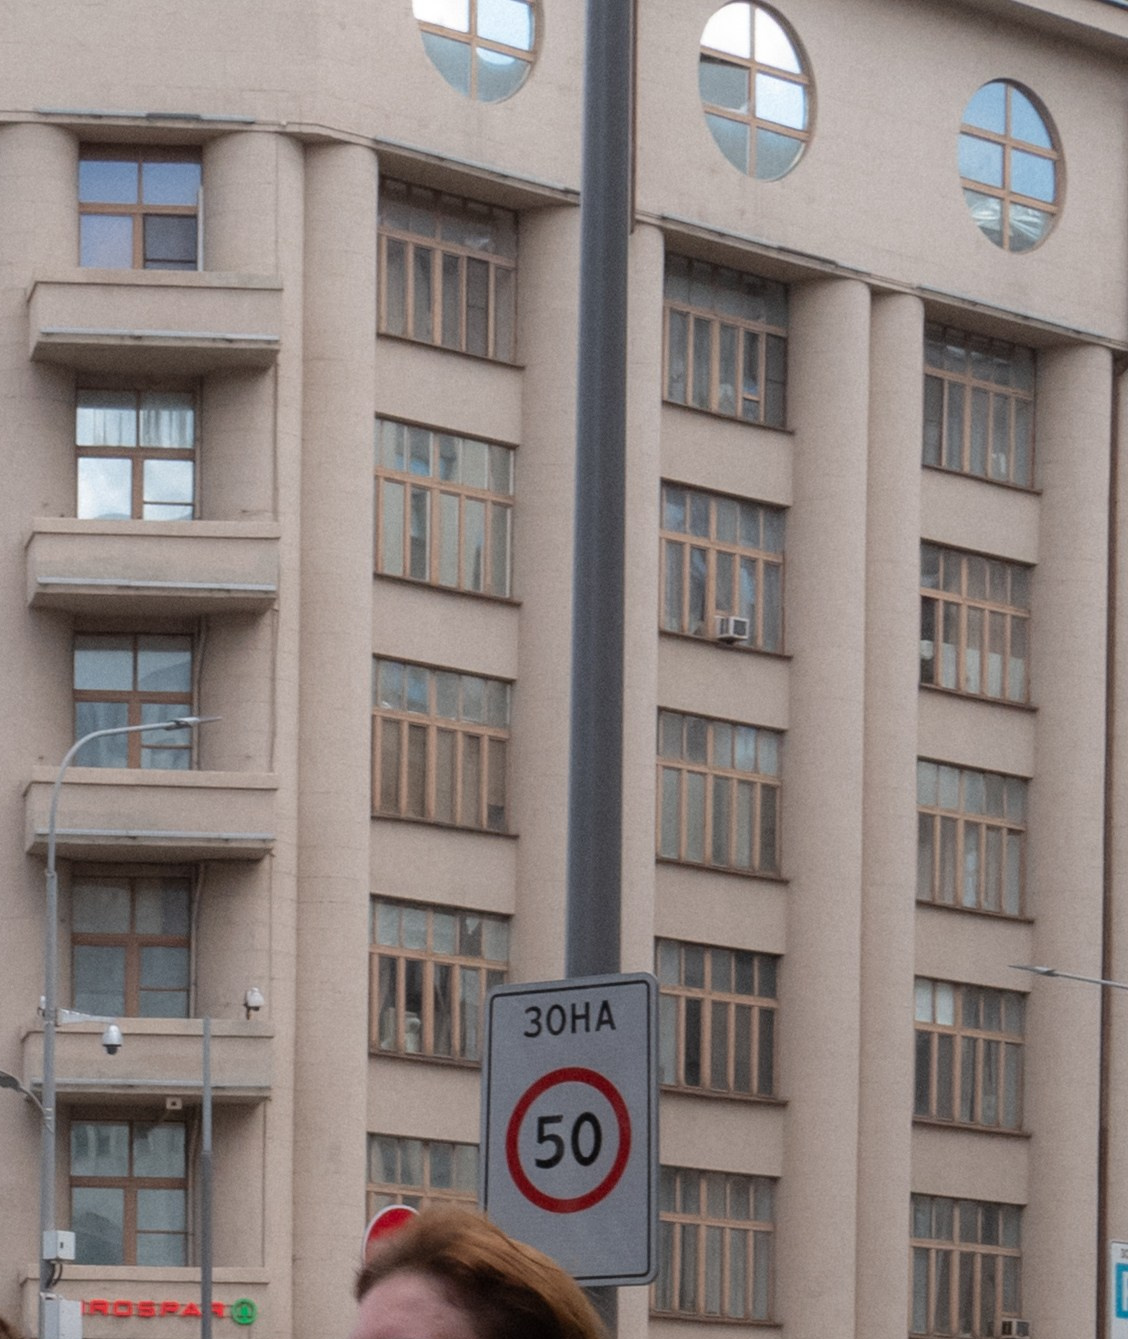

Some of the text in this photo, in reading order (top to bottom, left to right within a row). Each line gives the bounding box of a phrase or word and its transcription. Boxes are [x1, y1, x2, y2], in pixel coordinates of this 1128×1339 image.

[523, 1000, 616, 1038] ЗОНА
[534, 1111, 603, 1169] 50
[81, 1299, 226, 1318] ROSPAR
